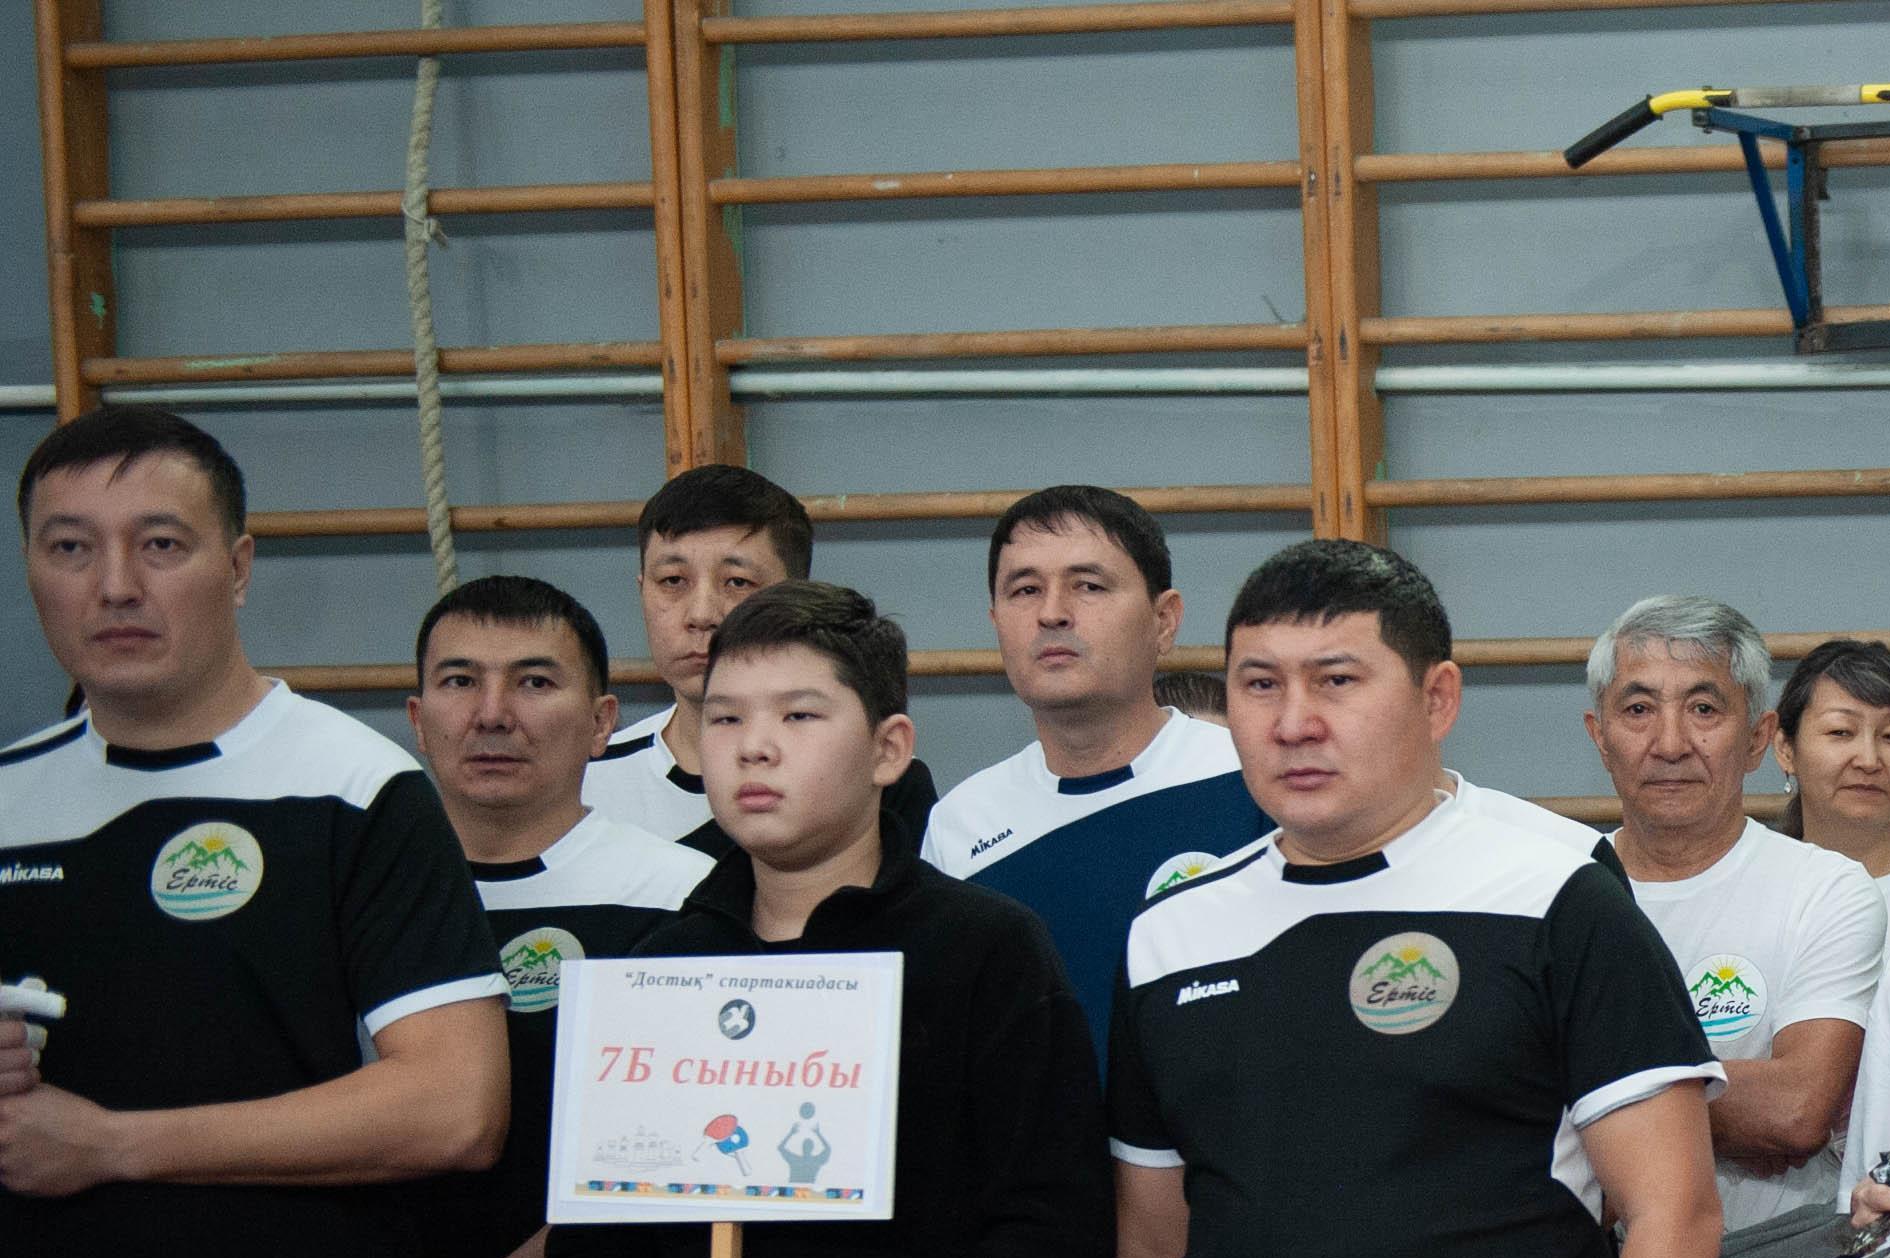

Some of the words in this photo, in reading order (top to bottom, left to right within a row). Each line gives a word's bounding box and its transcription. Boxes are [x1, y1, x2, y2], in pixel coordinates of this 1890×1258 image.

[719, 974, 859, 992] спартакиадасы
[596, 1046, 656, 1083] 7Б
[671, 1050, 864, 1089] сыныбы
